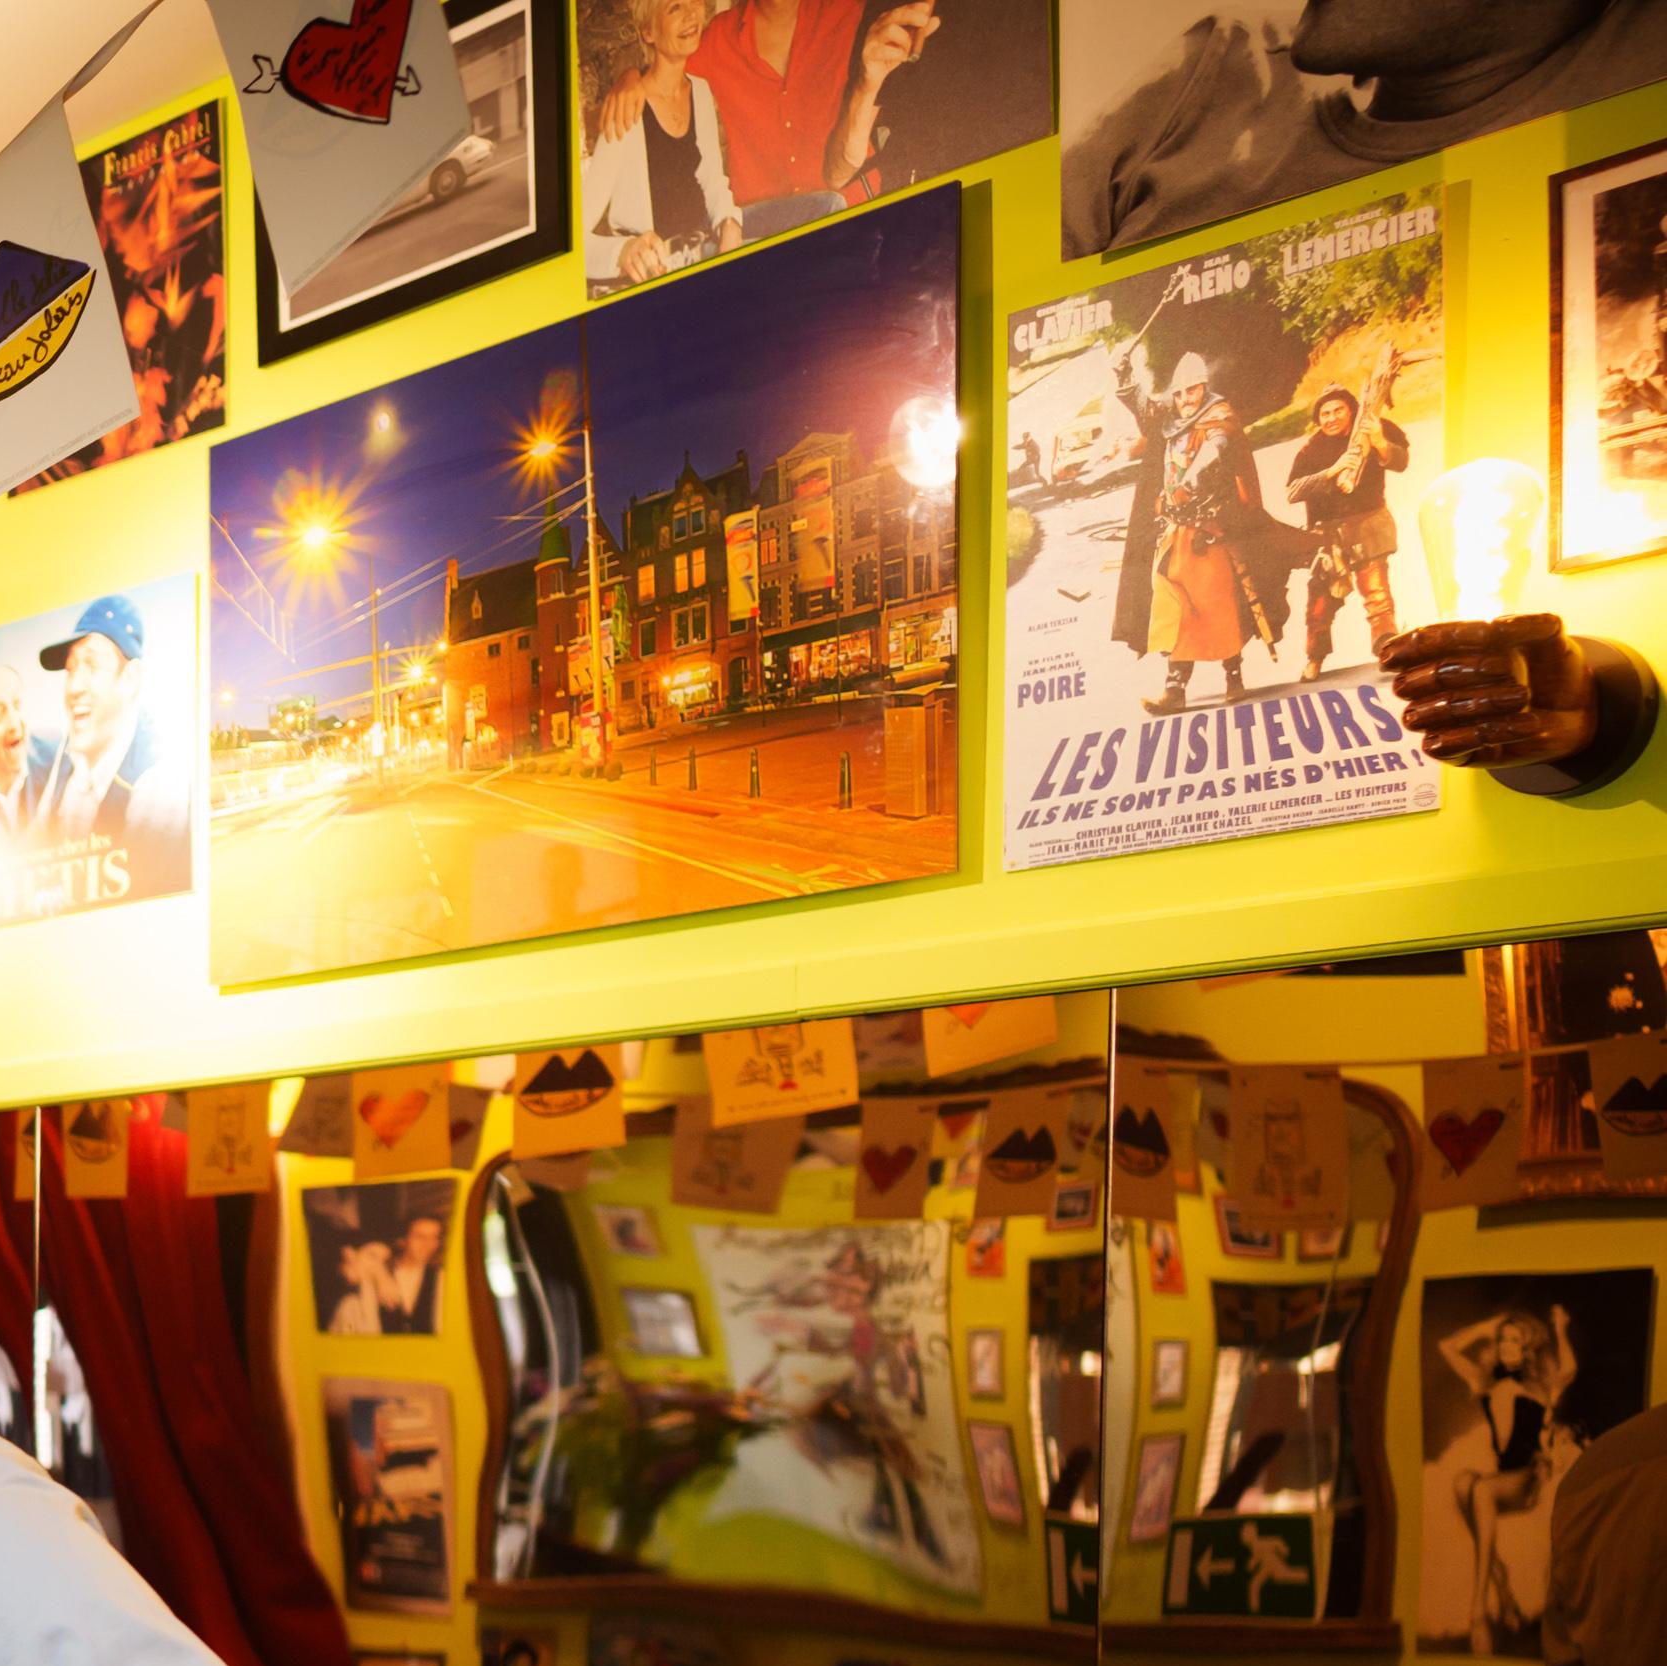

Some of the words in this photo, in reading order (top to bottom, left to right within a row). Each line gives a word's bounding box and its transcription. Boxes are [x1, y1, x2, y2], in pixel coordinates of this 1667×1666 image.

[1281, 205, 1437, 277] LEMERCIER
[1183, 260, 1251, 304] RENO
[1014, 300, 1113, 352] CLAVIER
[1017, 667, 1086, 709] POIRÉ
[1031, 728, 1127, 801] LES
[1135, 684, 1403, 784] VISITEURS
[1017, 806, 1060, 830] ILS
[1062, 799, 1099, 822] NE
[1101, 787, 1171, 816] SONT
[1177, 777, 1236, 805] PAS
[1244, 766, 1296, 794] NÉS
[1303, 751, 1408, 785] D'HIER
[1076, 824, 1123, 841] CHRISTIAN
[1125, 818, 1162, 833] CLAVIER
[1170, 812, 1193, 826] JEAN
[1195, 808, 1220, 822] RENO
[1228, 801, 1266, 817] VALERIE
[1269, 794, 1322, 811] LEMERCIER
[1334, 789, 1352, 801] LES
[1355, 782, 1407, 798] VISITEURS
[1047, 836, 1105, 855] JEAN-MARIE
[1146, 821, 1209, 840] MARIE-ANNE
[1213, 815, 1253, 829] CHAZEL
